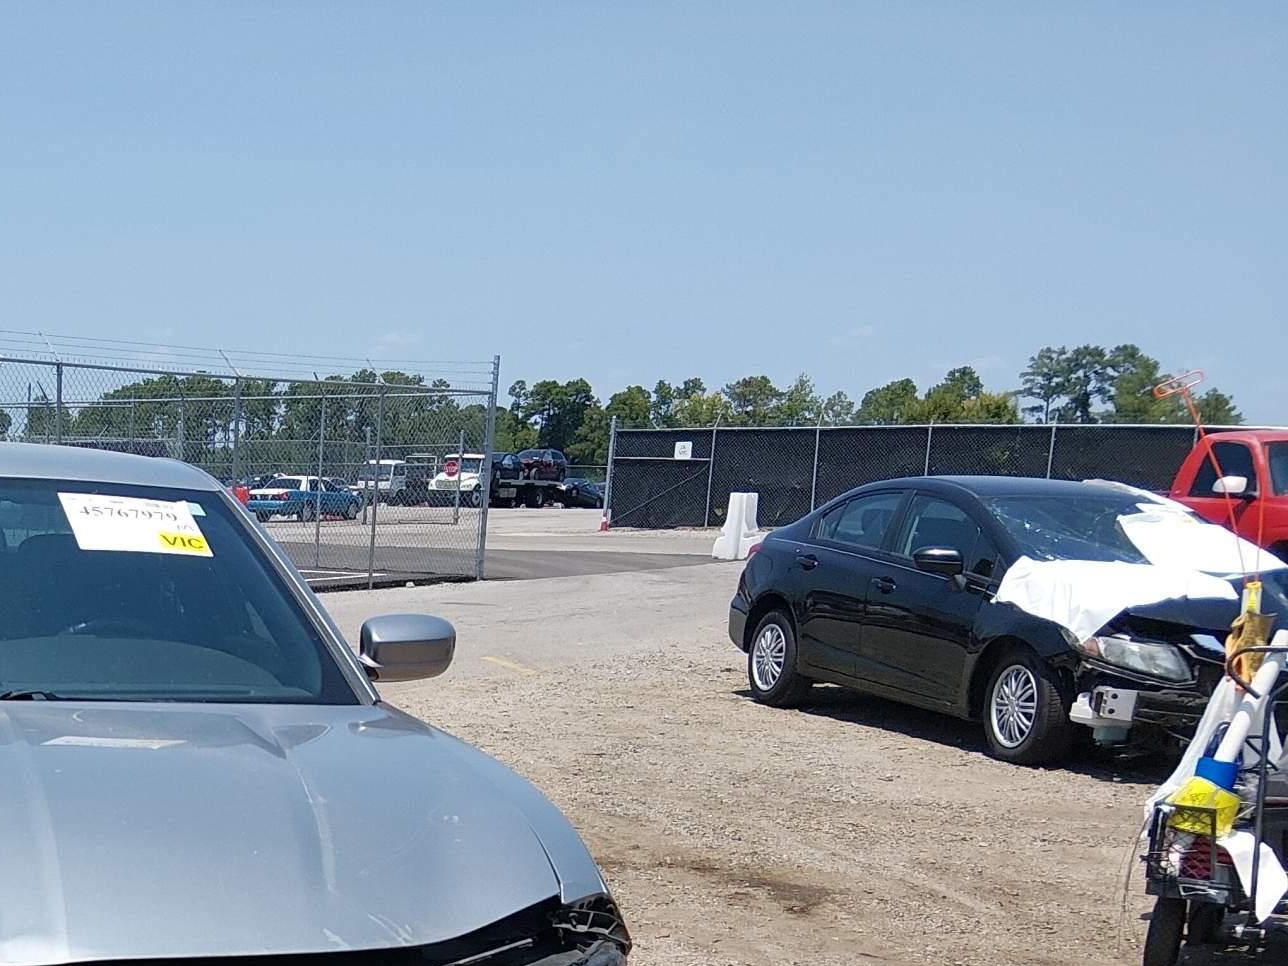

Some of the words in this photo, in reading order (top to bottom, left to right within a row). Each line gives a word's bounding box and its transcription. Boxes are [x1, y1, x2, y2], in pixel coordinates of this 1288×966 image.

[445, 465, 458, 473] STOP
[80, 505, 178, 522] 45767979
[160, 533, 204, 550] VIC
